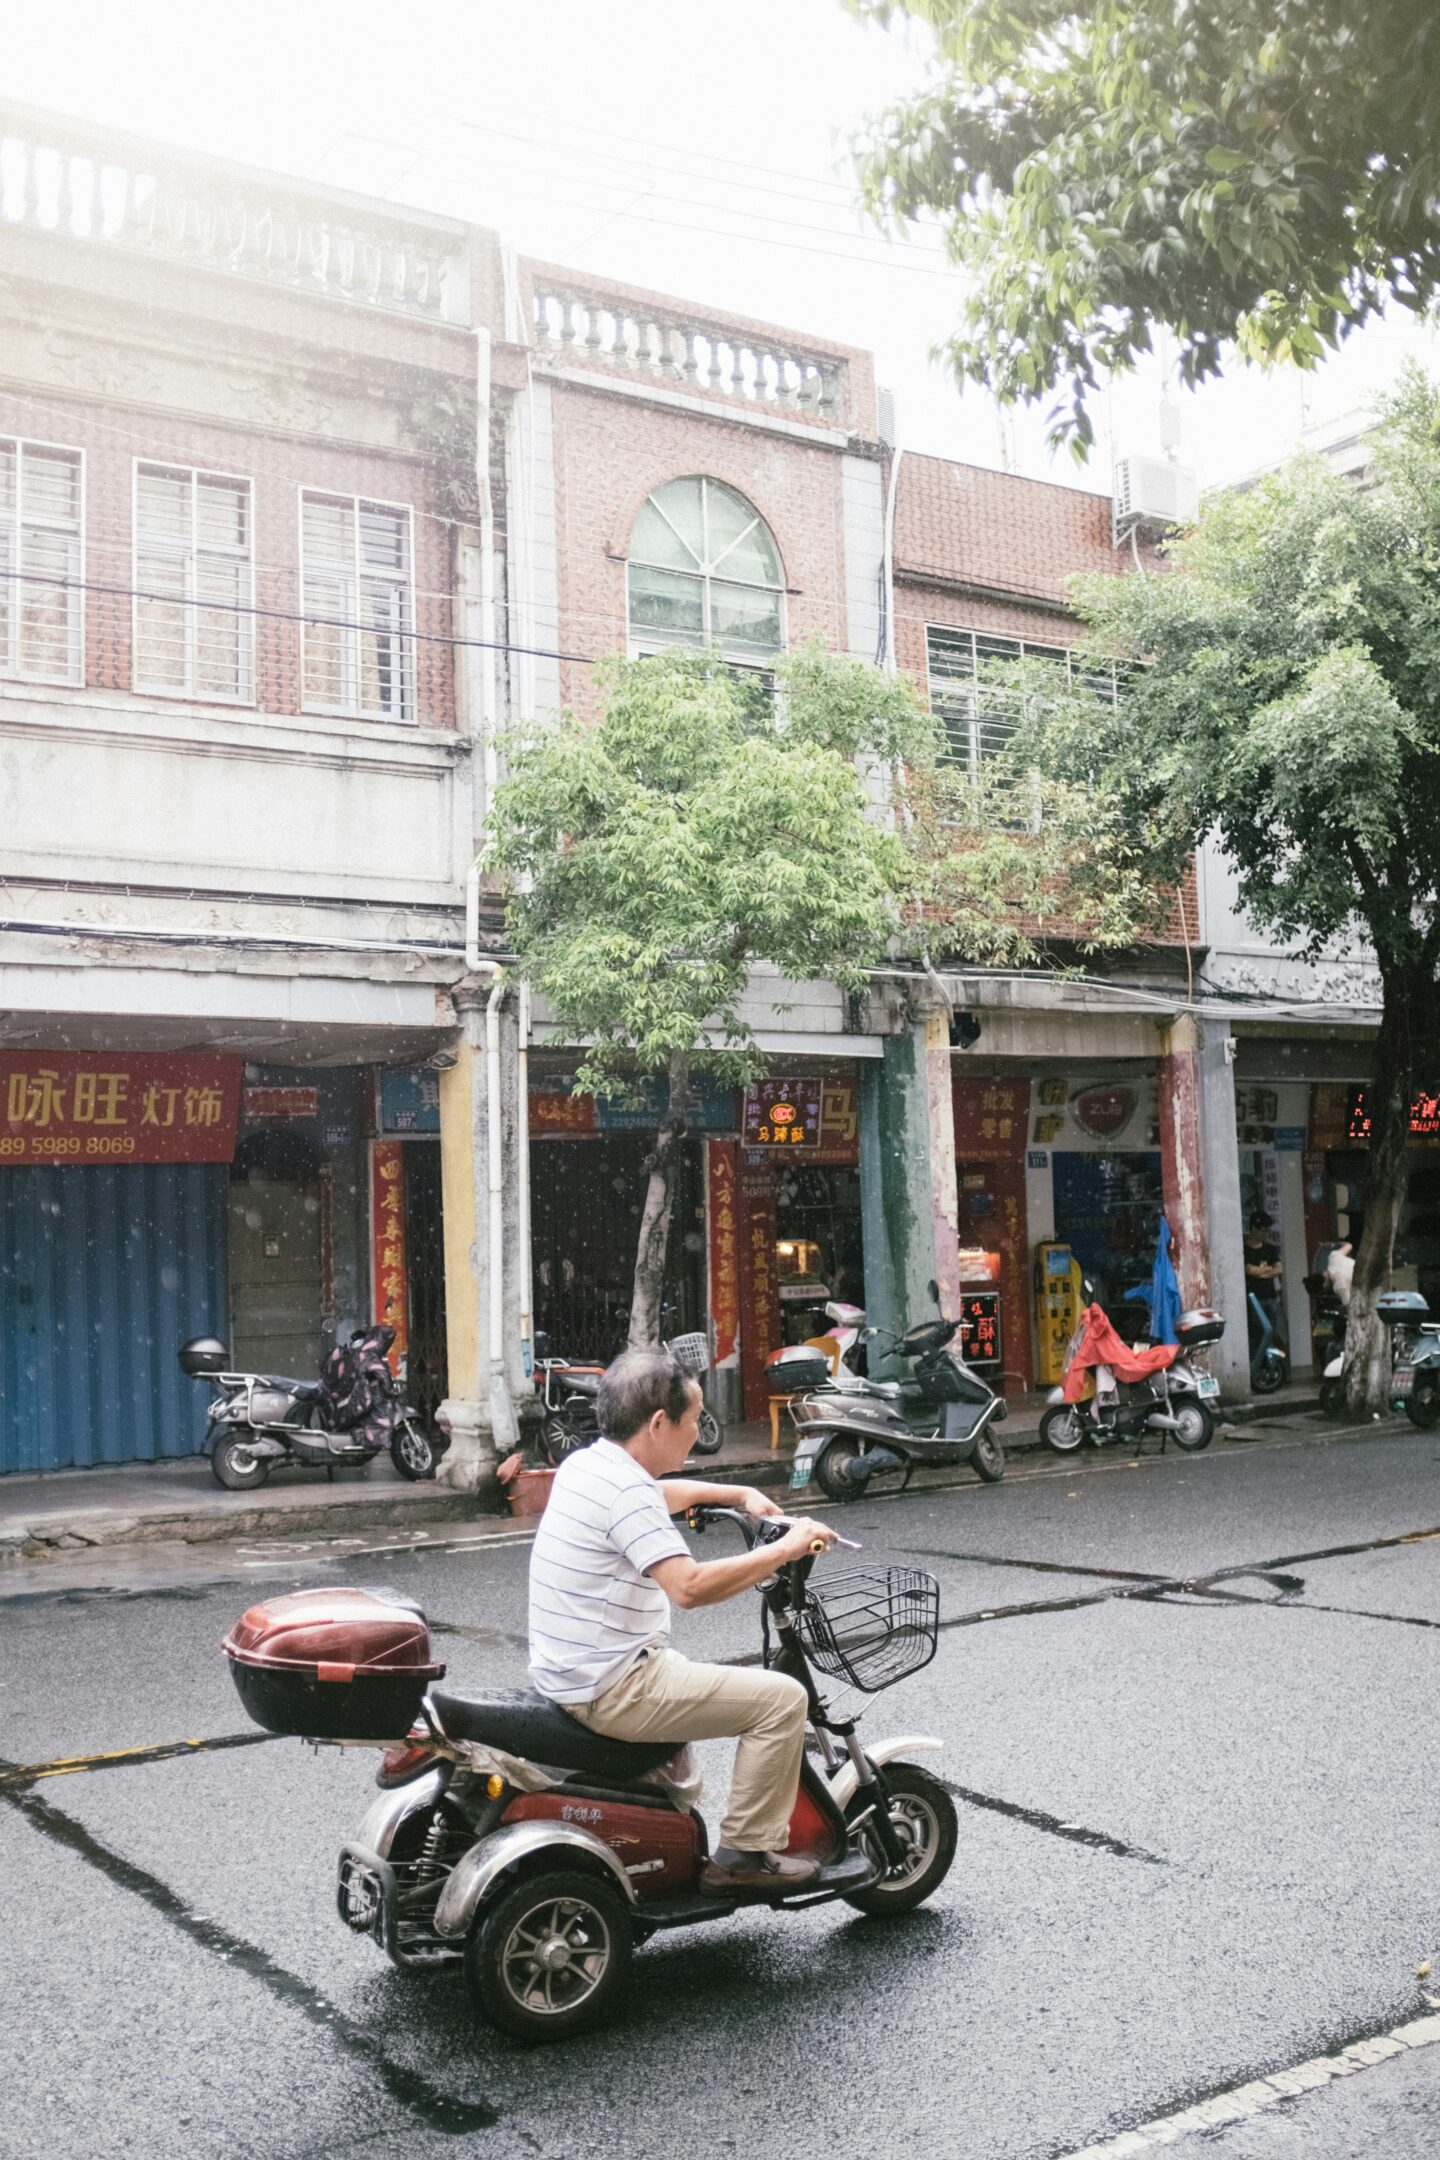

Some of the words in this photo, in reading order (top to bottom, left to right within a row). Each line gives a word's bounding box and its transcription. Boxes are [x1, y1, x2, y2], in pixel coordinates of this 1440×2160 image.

[7, 1068, 224, 1127] 咏旺灯饰
[32, 1137, 80, 1155] 5989
[86, 1137, 135, 1154] 8069
